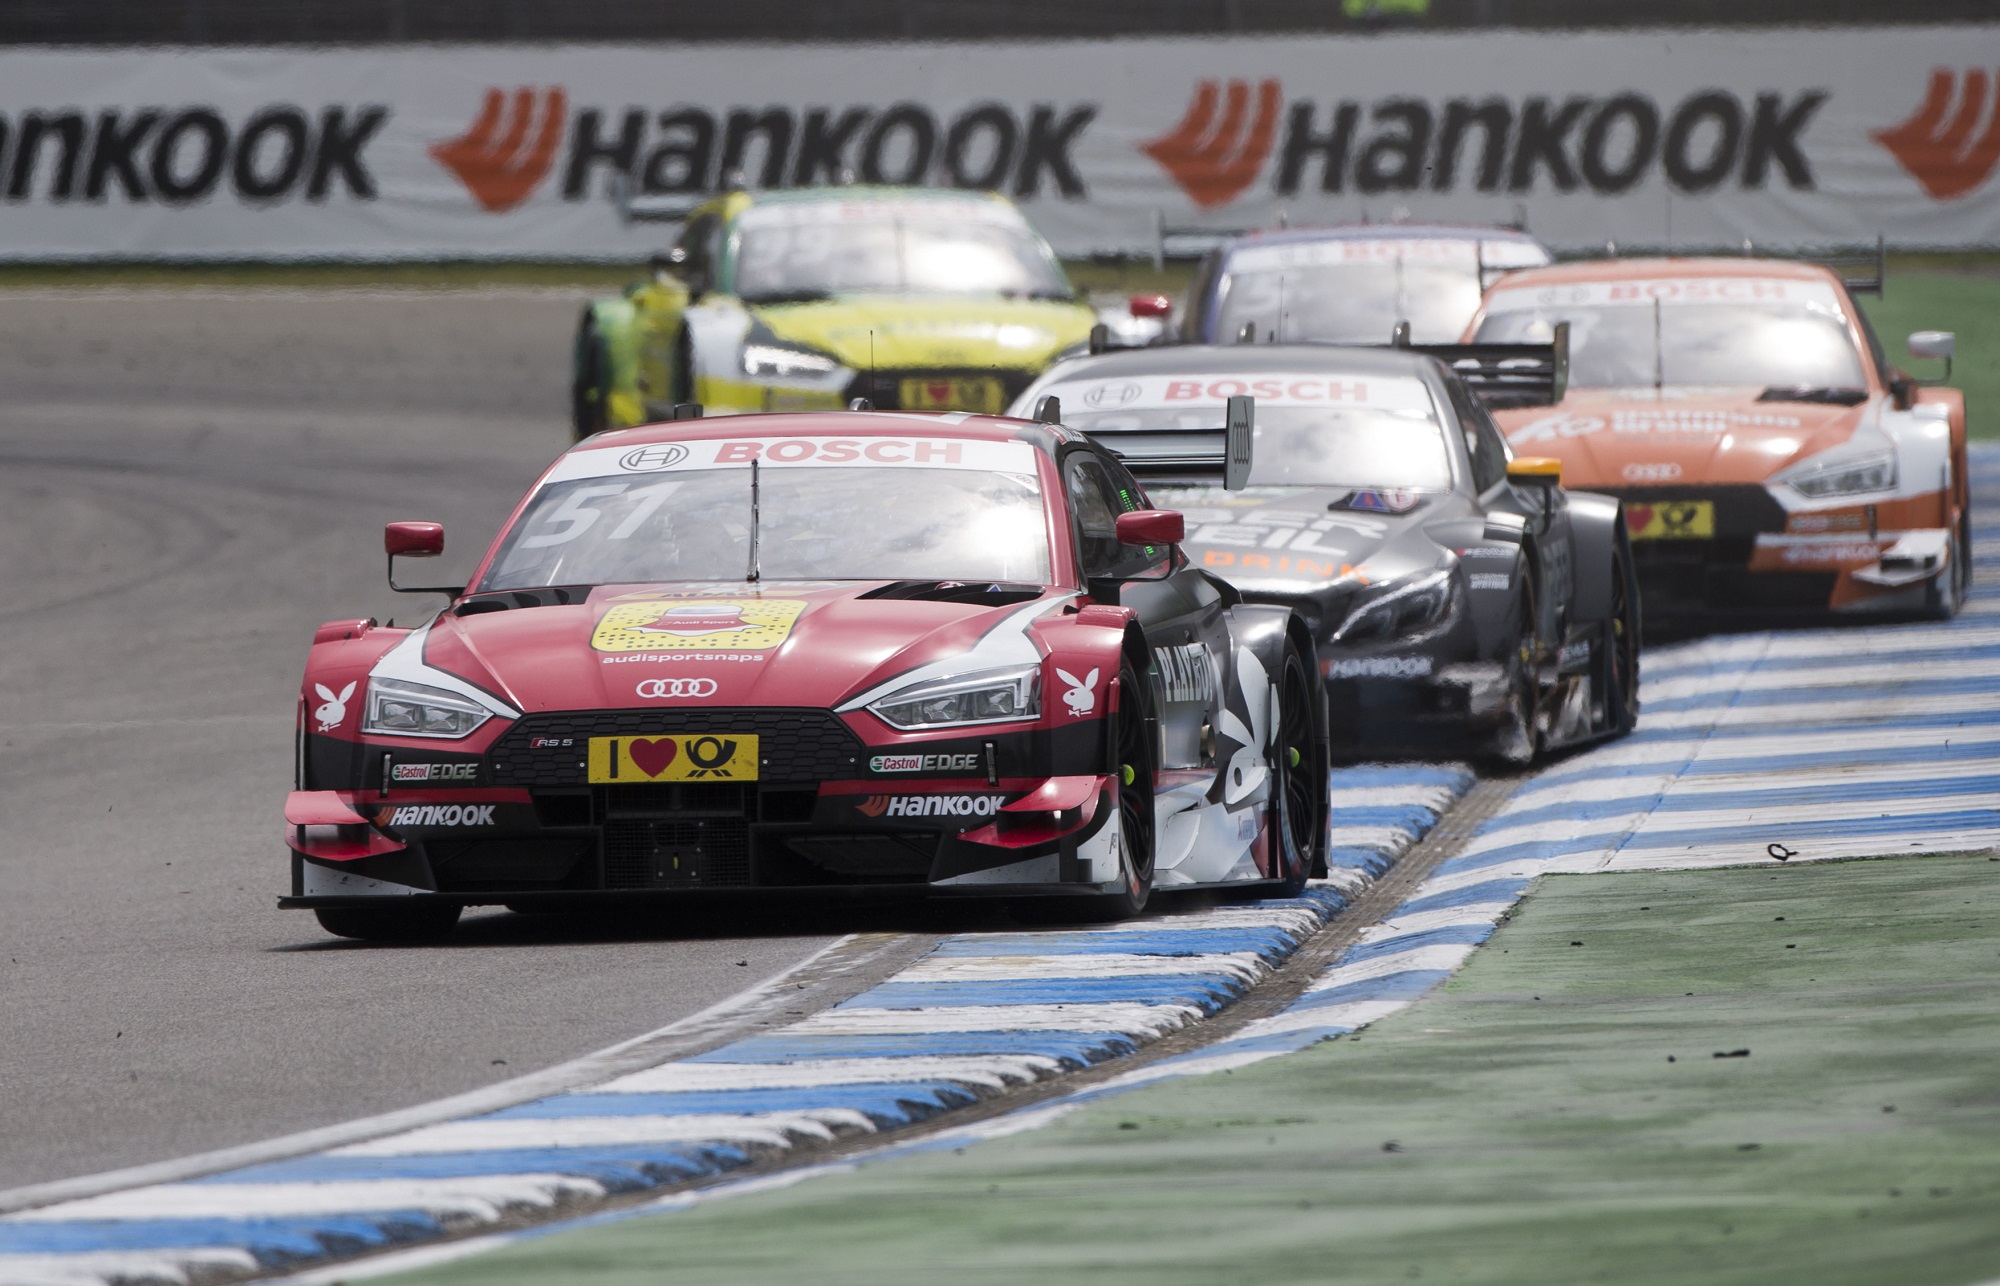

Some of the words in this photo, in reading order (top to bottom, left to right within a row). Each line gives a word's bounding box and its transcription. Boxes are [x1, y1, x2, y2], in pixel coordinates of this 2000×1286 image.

[0, 102, 394, 205] nKOOK
[1608, 280, 1787, 300] BOSCH
[1164, 380, 1368, 402] BOSCH
[712, 440, 963, 465] BOSCH
[520, 481, 686, 549] 51
[1204, 551, 1372, 585] DRINK
[603, 653, 764, 664] audisportsnaps
[536, 739, 560, 747] RS
[609, 740, 619, 779] I
[883, 757, 919, 770] Castrol
[922, 754, 979, 771] EDGE
[401, 765, 427, 779] Castrol
[429, 763, 479, 780] EDGE
